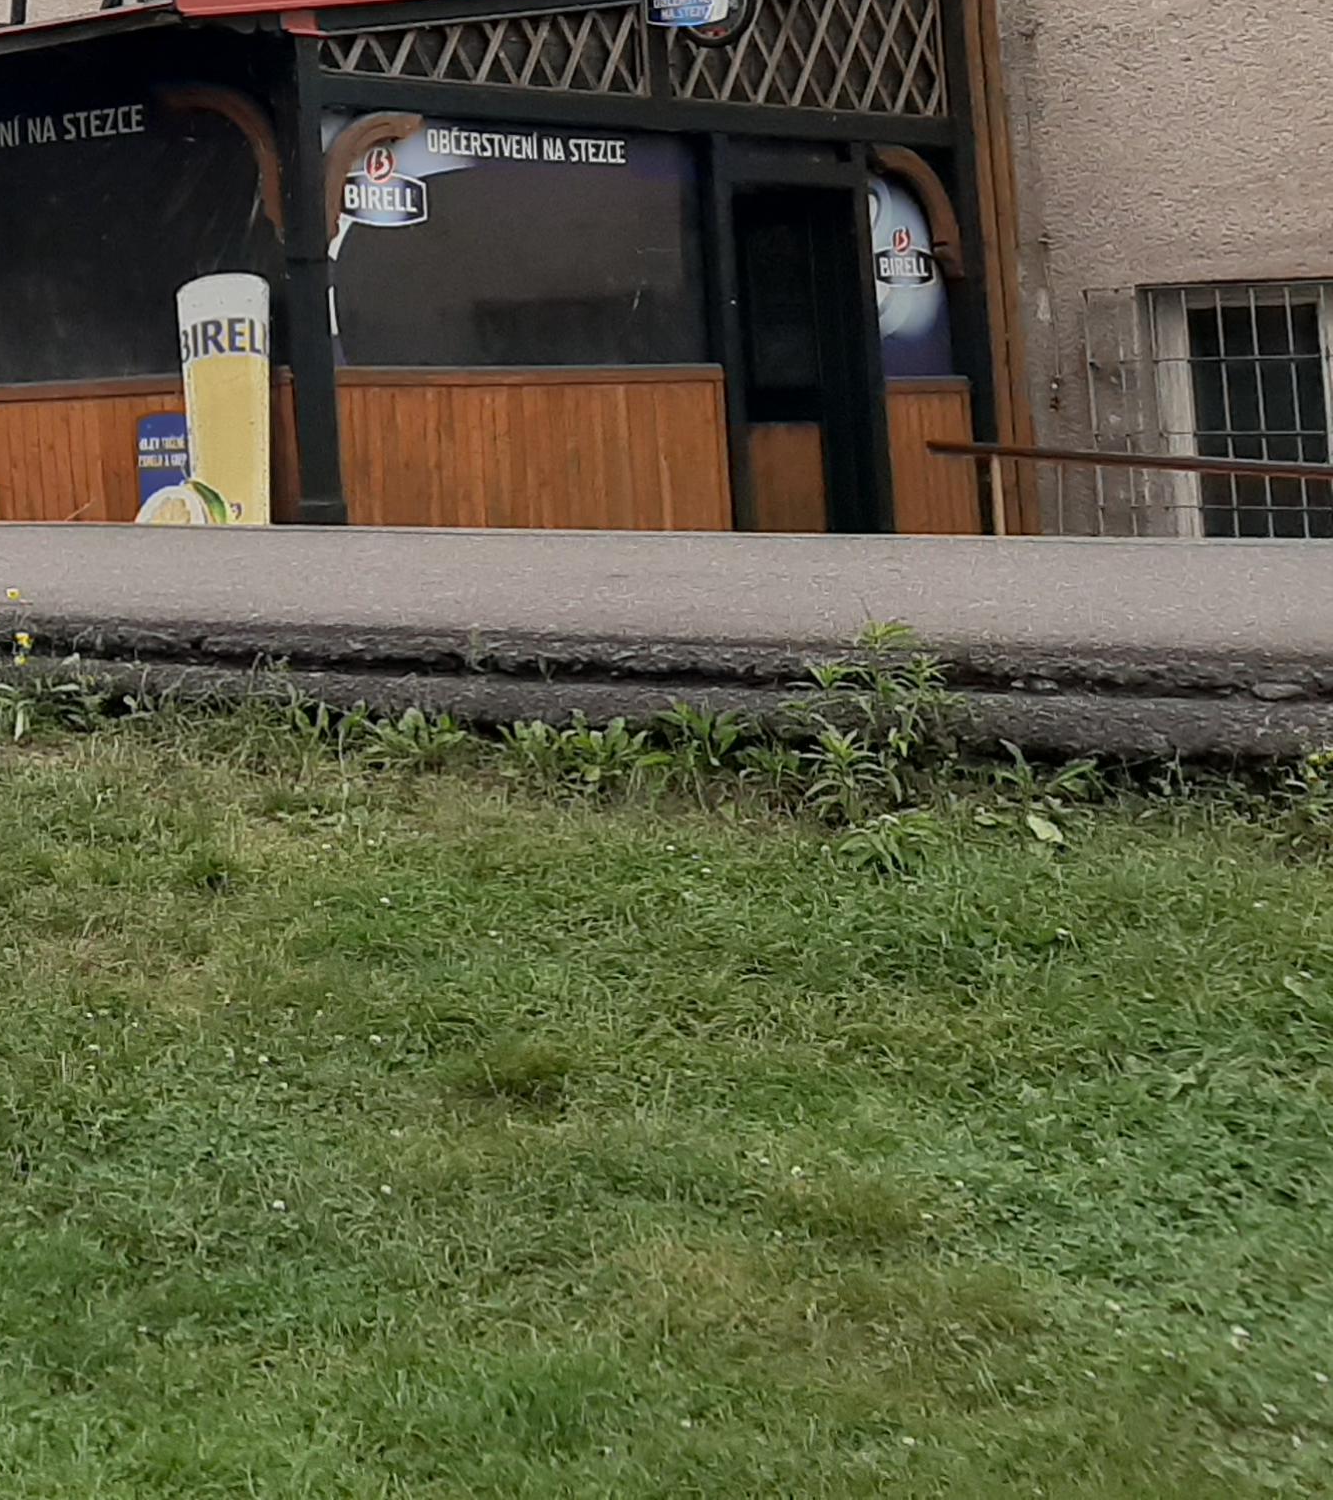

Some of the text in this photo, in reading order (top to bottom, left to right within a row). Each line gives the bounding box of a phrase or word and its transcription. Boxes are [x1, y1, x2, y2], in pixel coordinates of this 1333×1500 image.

[27, 116, 57, 144] NA
[63, 104, 145, 141] STEZCE
[426, 127, 626, 164] OBČERSTVENÍ NA STEZCE
[344, 184, 417, 212] BIRELL
[879, 257, 929, 277] BIRELL
